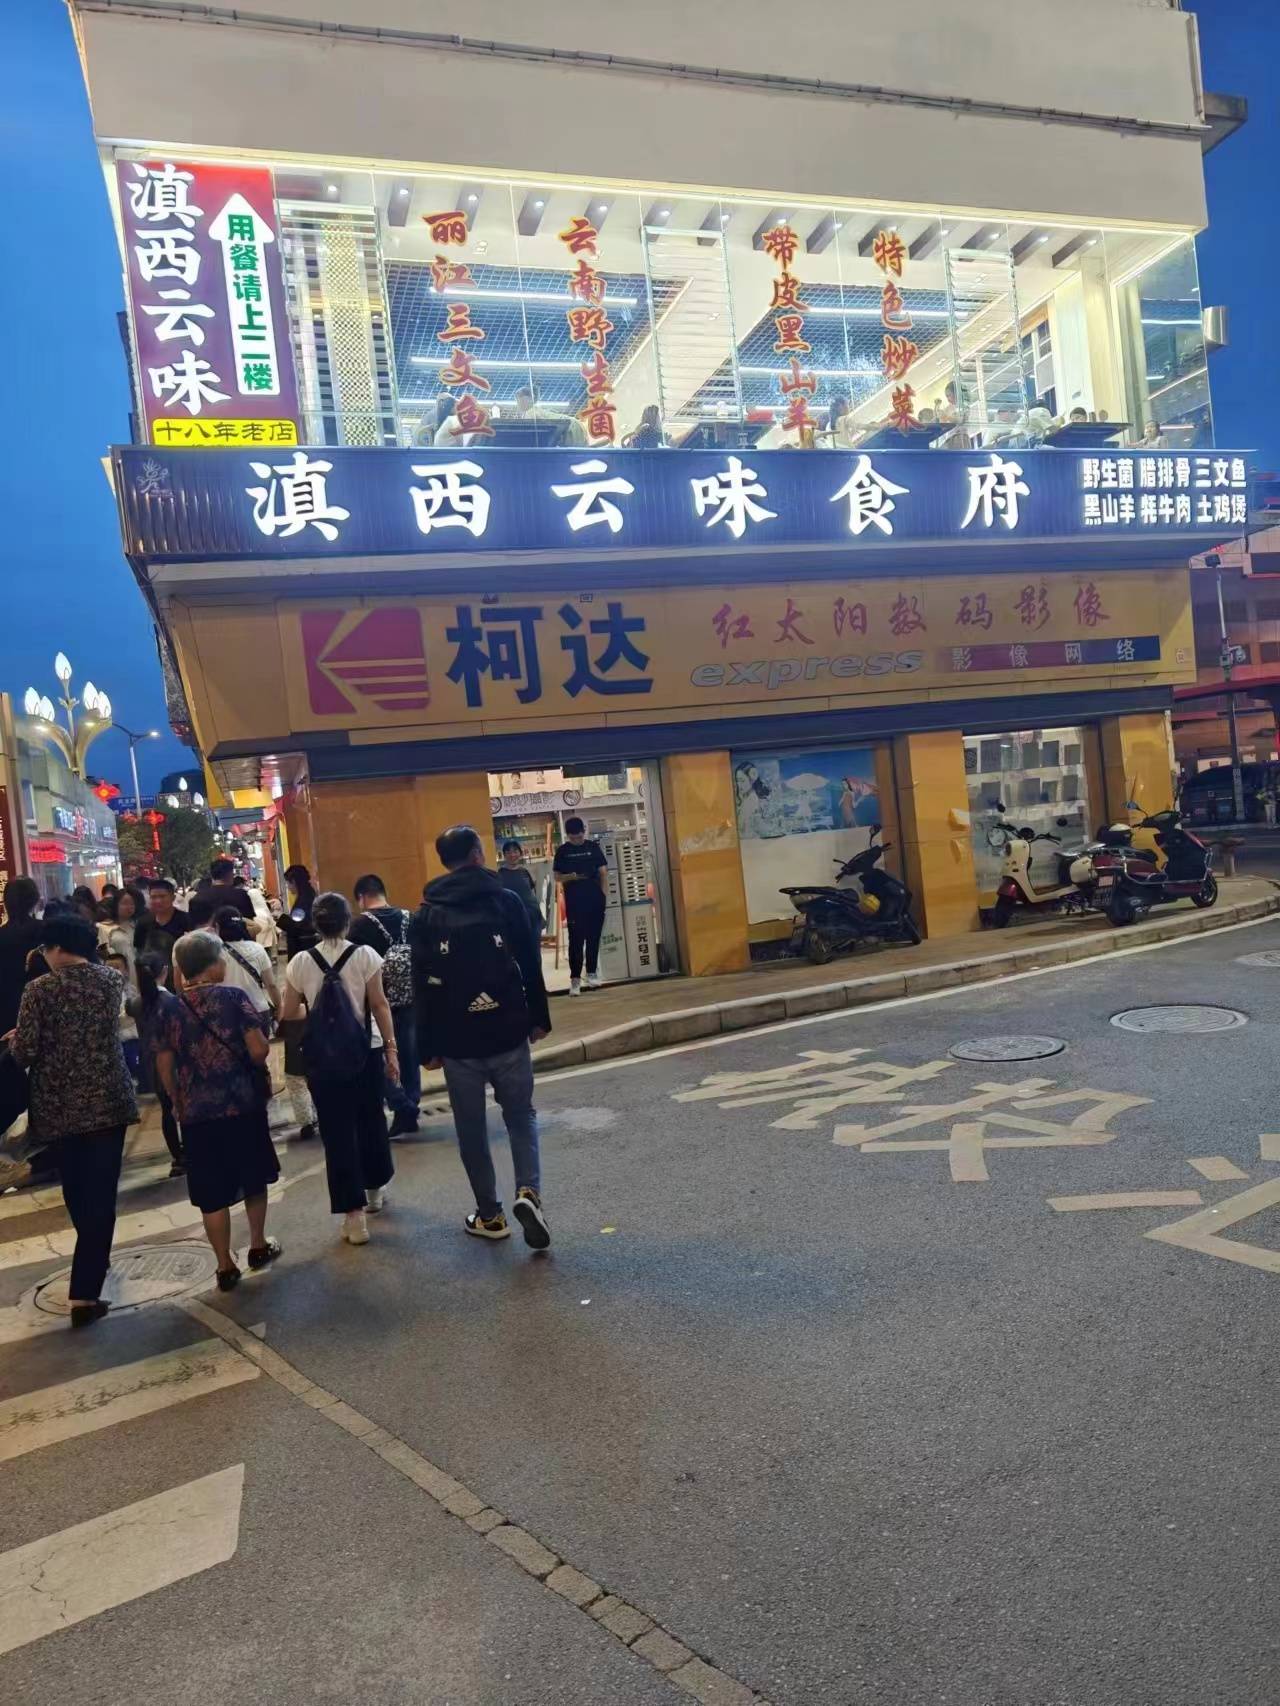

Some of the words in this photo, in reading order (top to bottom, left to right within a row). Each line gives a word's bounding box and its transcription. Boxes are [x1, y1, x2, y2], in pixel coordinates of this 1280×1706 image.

[126, 163, 232, 415] 滇西云味
[227, 214, 274, 392] 用餐请上二楼
[423, 210, 492, 438] 丽江三文鱼
[560, 216, 616, 445] 云南野生菌
[761, 226, 819, 436] 带皮黑山羊
[872, 229, 926, 435] 特色炒菜
[156, 421, 293, 442] 十八年老店
[1083, 457, 1134, 488] 野生菌
[1140, 457, 1191, 488] 腊排骨
[1196, 457, 1247, 488] 三文鱼
[244, 451, 1031, 541] 滇西云味食府
[1084, 493, 1136, 525] 黑山羊
[1141, 493, 1192, 524] 牦牛肉
[1197, 493, 1247, 524] 土鸡煲
[445, 601, 654, 708] 柯达
[712, 584, 1111, 648] 红太阳数码影像
[952, 638, 1136, 671] 影像网络
[690, 649, 924, 690] express
